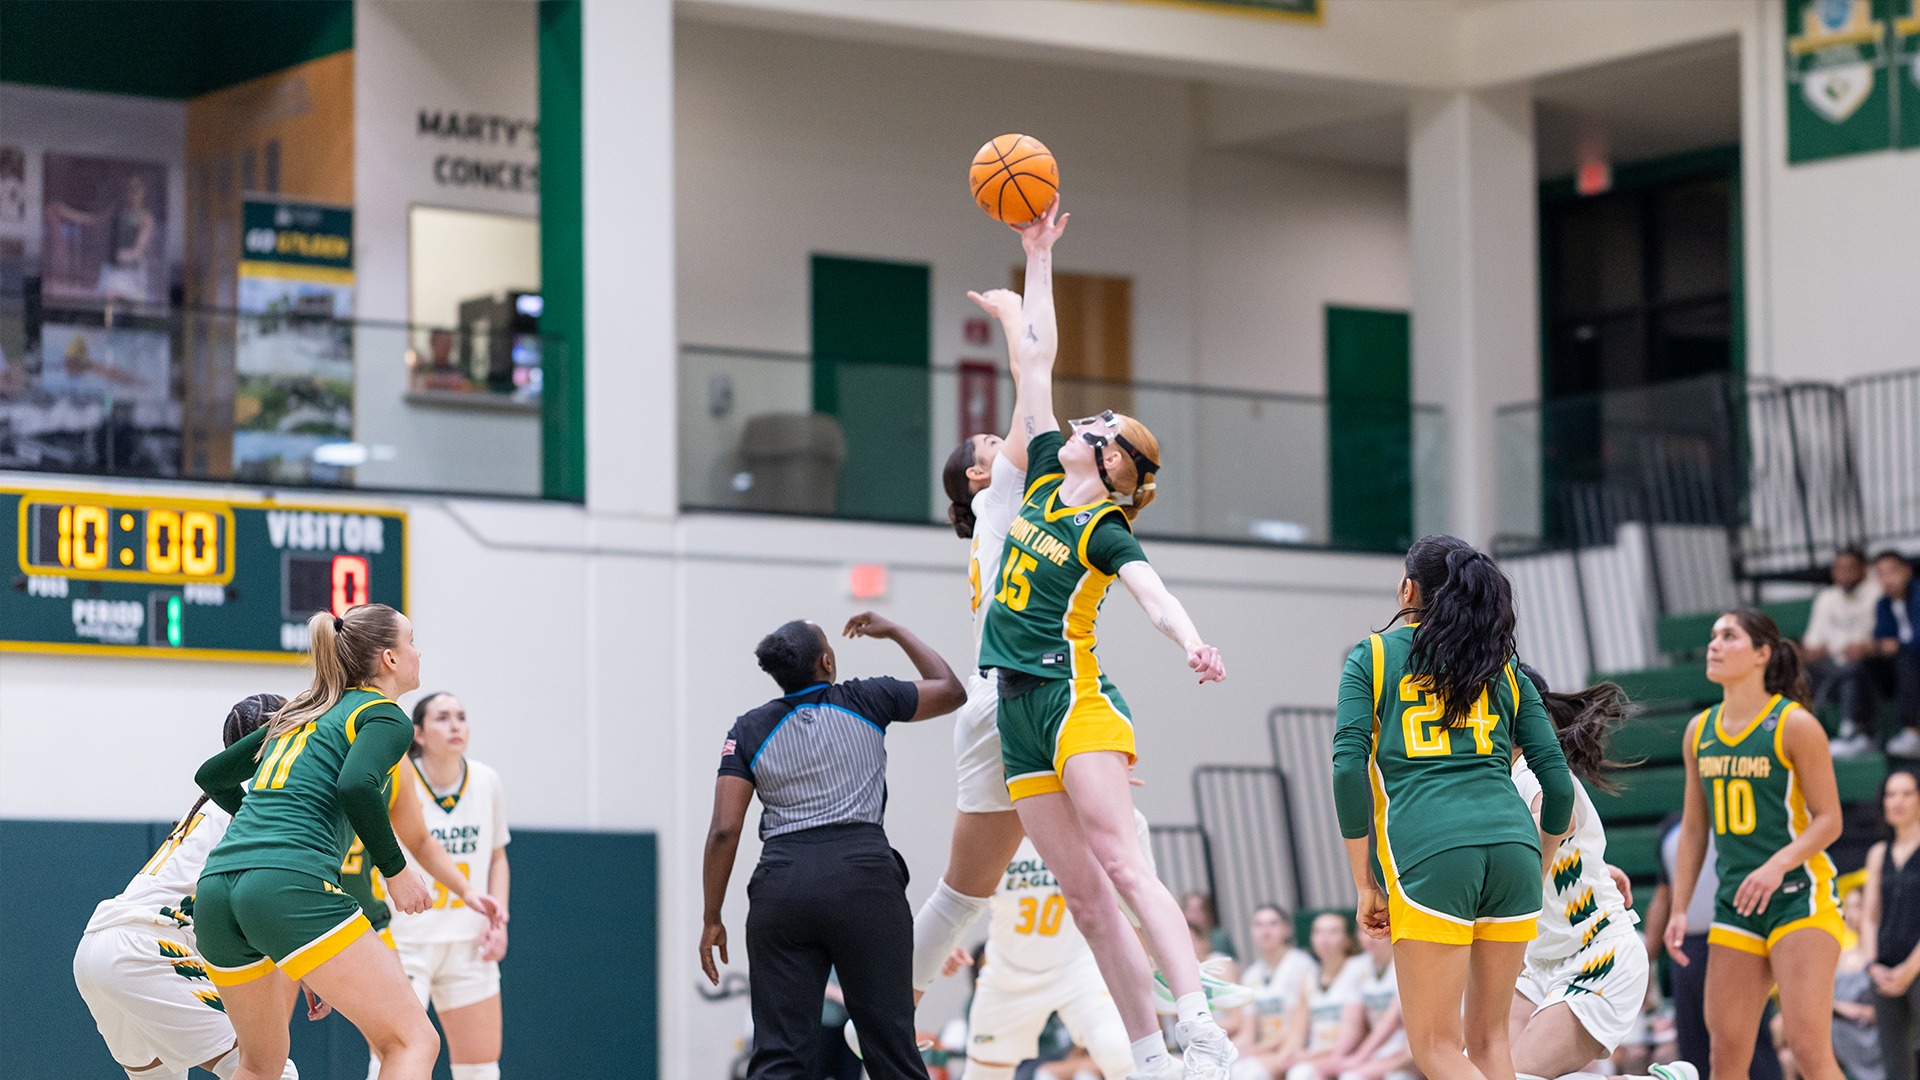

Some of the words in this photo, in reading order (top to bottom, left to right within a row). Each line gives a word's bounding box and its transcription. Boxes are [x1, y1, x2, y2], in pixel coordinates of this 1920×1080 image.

[58, 504, 218, 576] 10:00
[266, 511, 384, 553] VISITOR
[1031, 530, 1070, 567] LOMA
[331, 555, 369, 618] 0
[994, 546, 1039, 611] 15
[72, 599, 144, 628] PERIOD
[1399, 673, 1500, 758] 24
[253, 722, 317, 790] 11
[1730, 755, 1772, 778] LOMA
[1713, 779, 1756, 835] 10
[430, 826, 480, 840] OLDEN
[1015, 894, 1067, 936] 30
